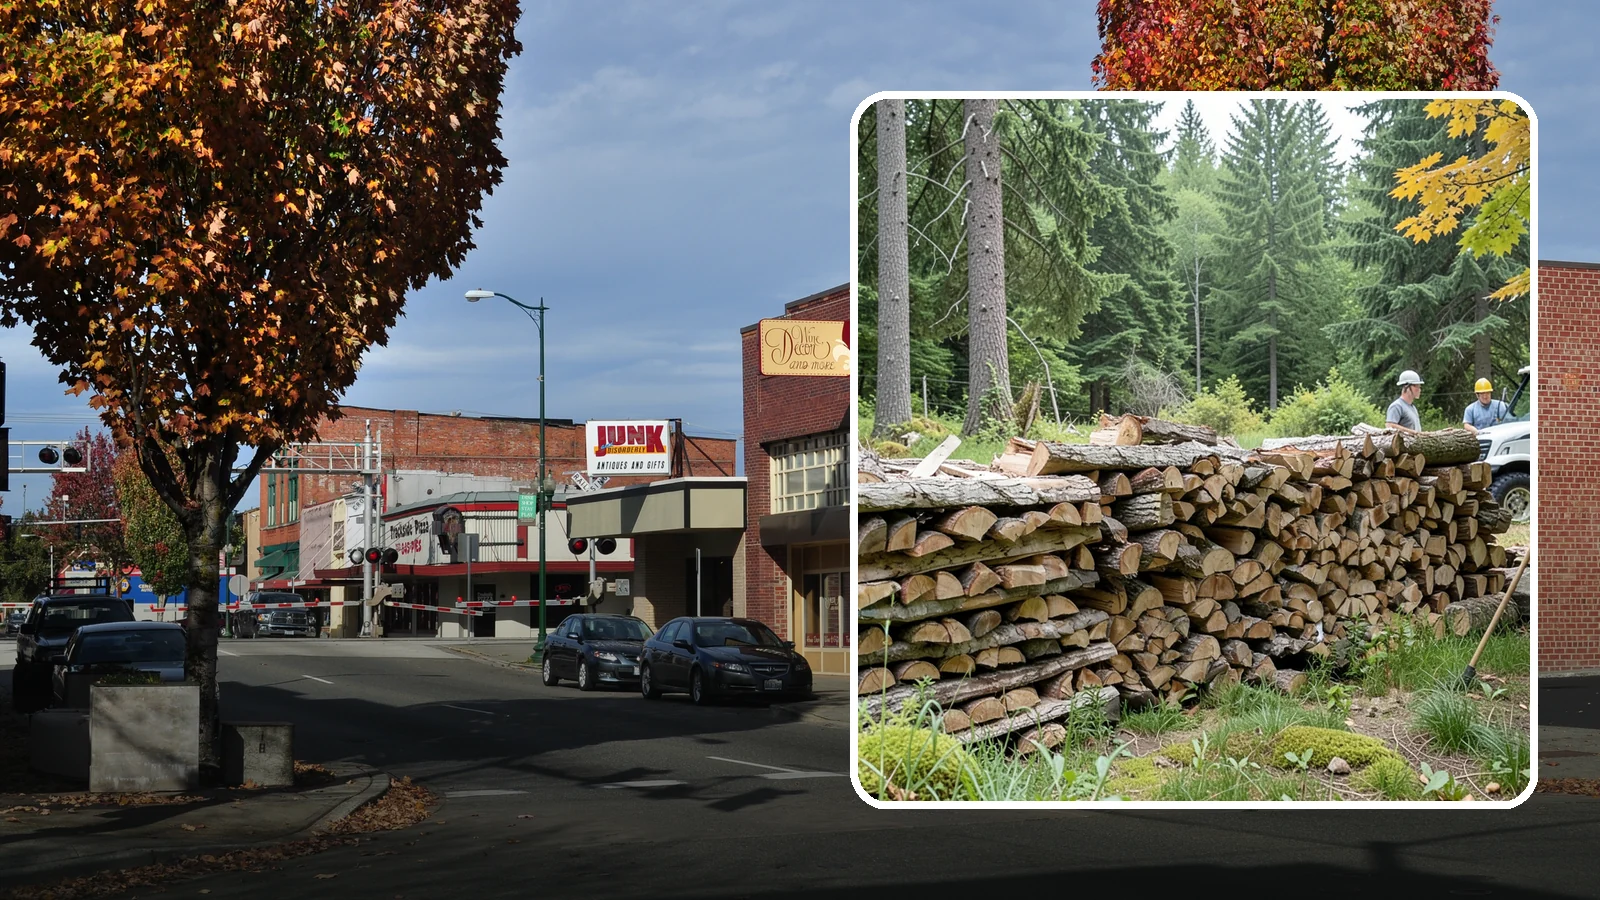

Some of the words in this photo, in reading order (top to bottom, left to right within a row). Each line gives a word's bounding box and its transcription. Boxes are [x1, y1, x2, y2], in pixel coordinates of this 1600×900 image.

[765, 327, 831, 365] Decor
[595, 425, 665, 457] JUNK
[608, 446, 646, 454] DISORDERLY
[597, 461, 628, 470] ANTIQUES
[631, 461, 644, 469] AND
[647, 460, 665, 469] GIFTS
[352, 498, 364, 510] CRO
[390, 521, 413, 540] Trackside
[415, 519, 429, 535] Pizza
